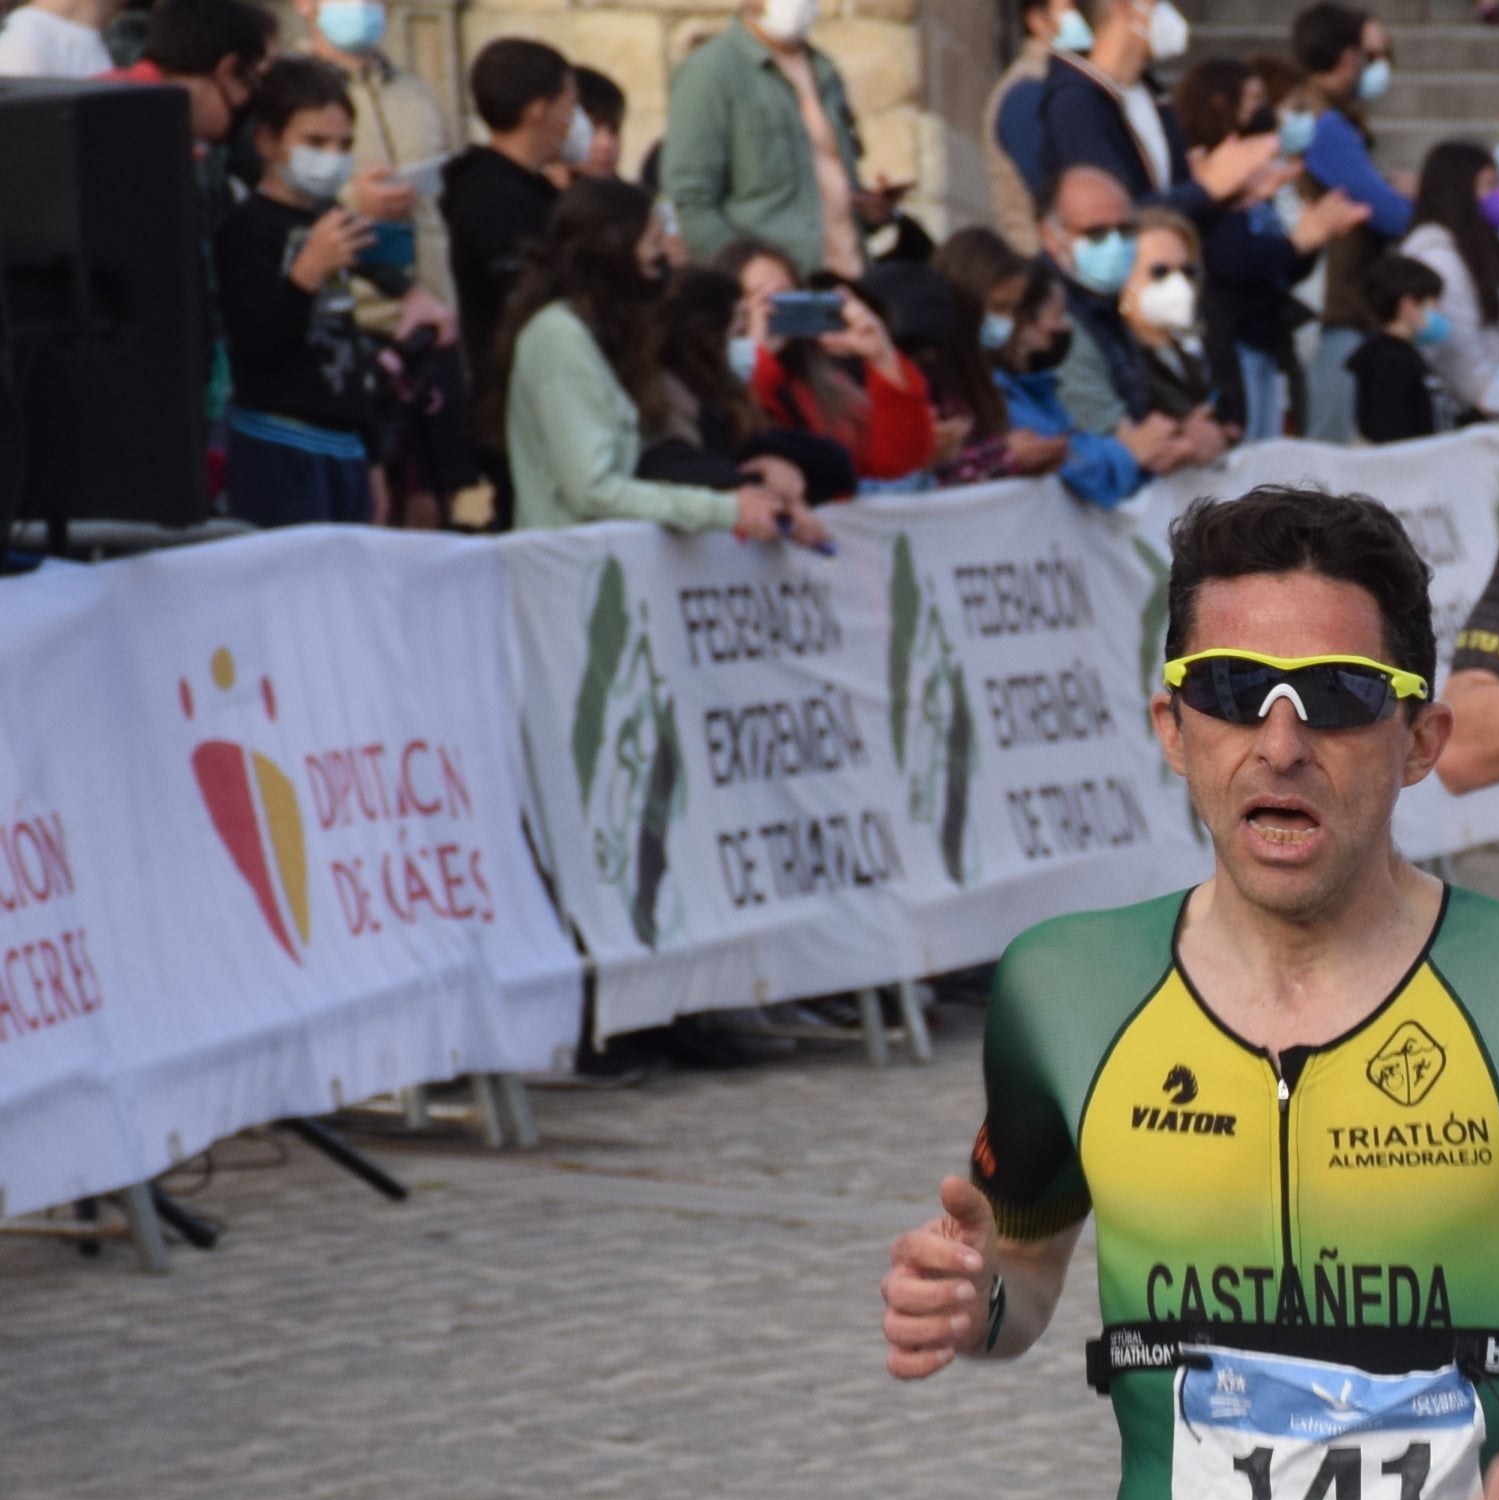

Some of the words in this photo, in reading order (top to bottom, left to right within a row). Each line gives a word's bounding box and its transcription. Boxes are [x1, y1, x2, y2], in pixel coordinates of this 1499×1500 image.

[1131, 1106, 1237, 1137] VIATOR
[1327, 1110, 1490, 1150] TRIATLÓN
[1328, 1148, 1493, 1169] ALMENDRALEJO
[1146, 1246, 1454, 1328] CASTAÑEDA
